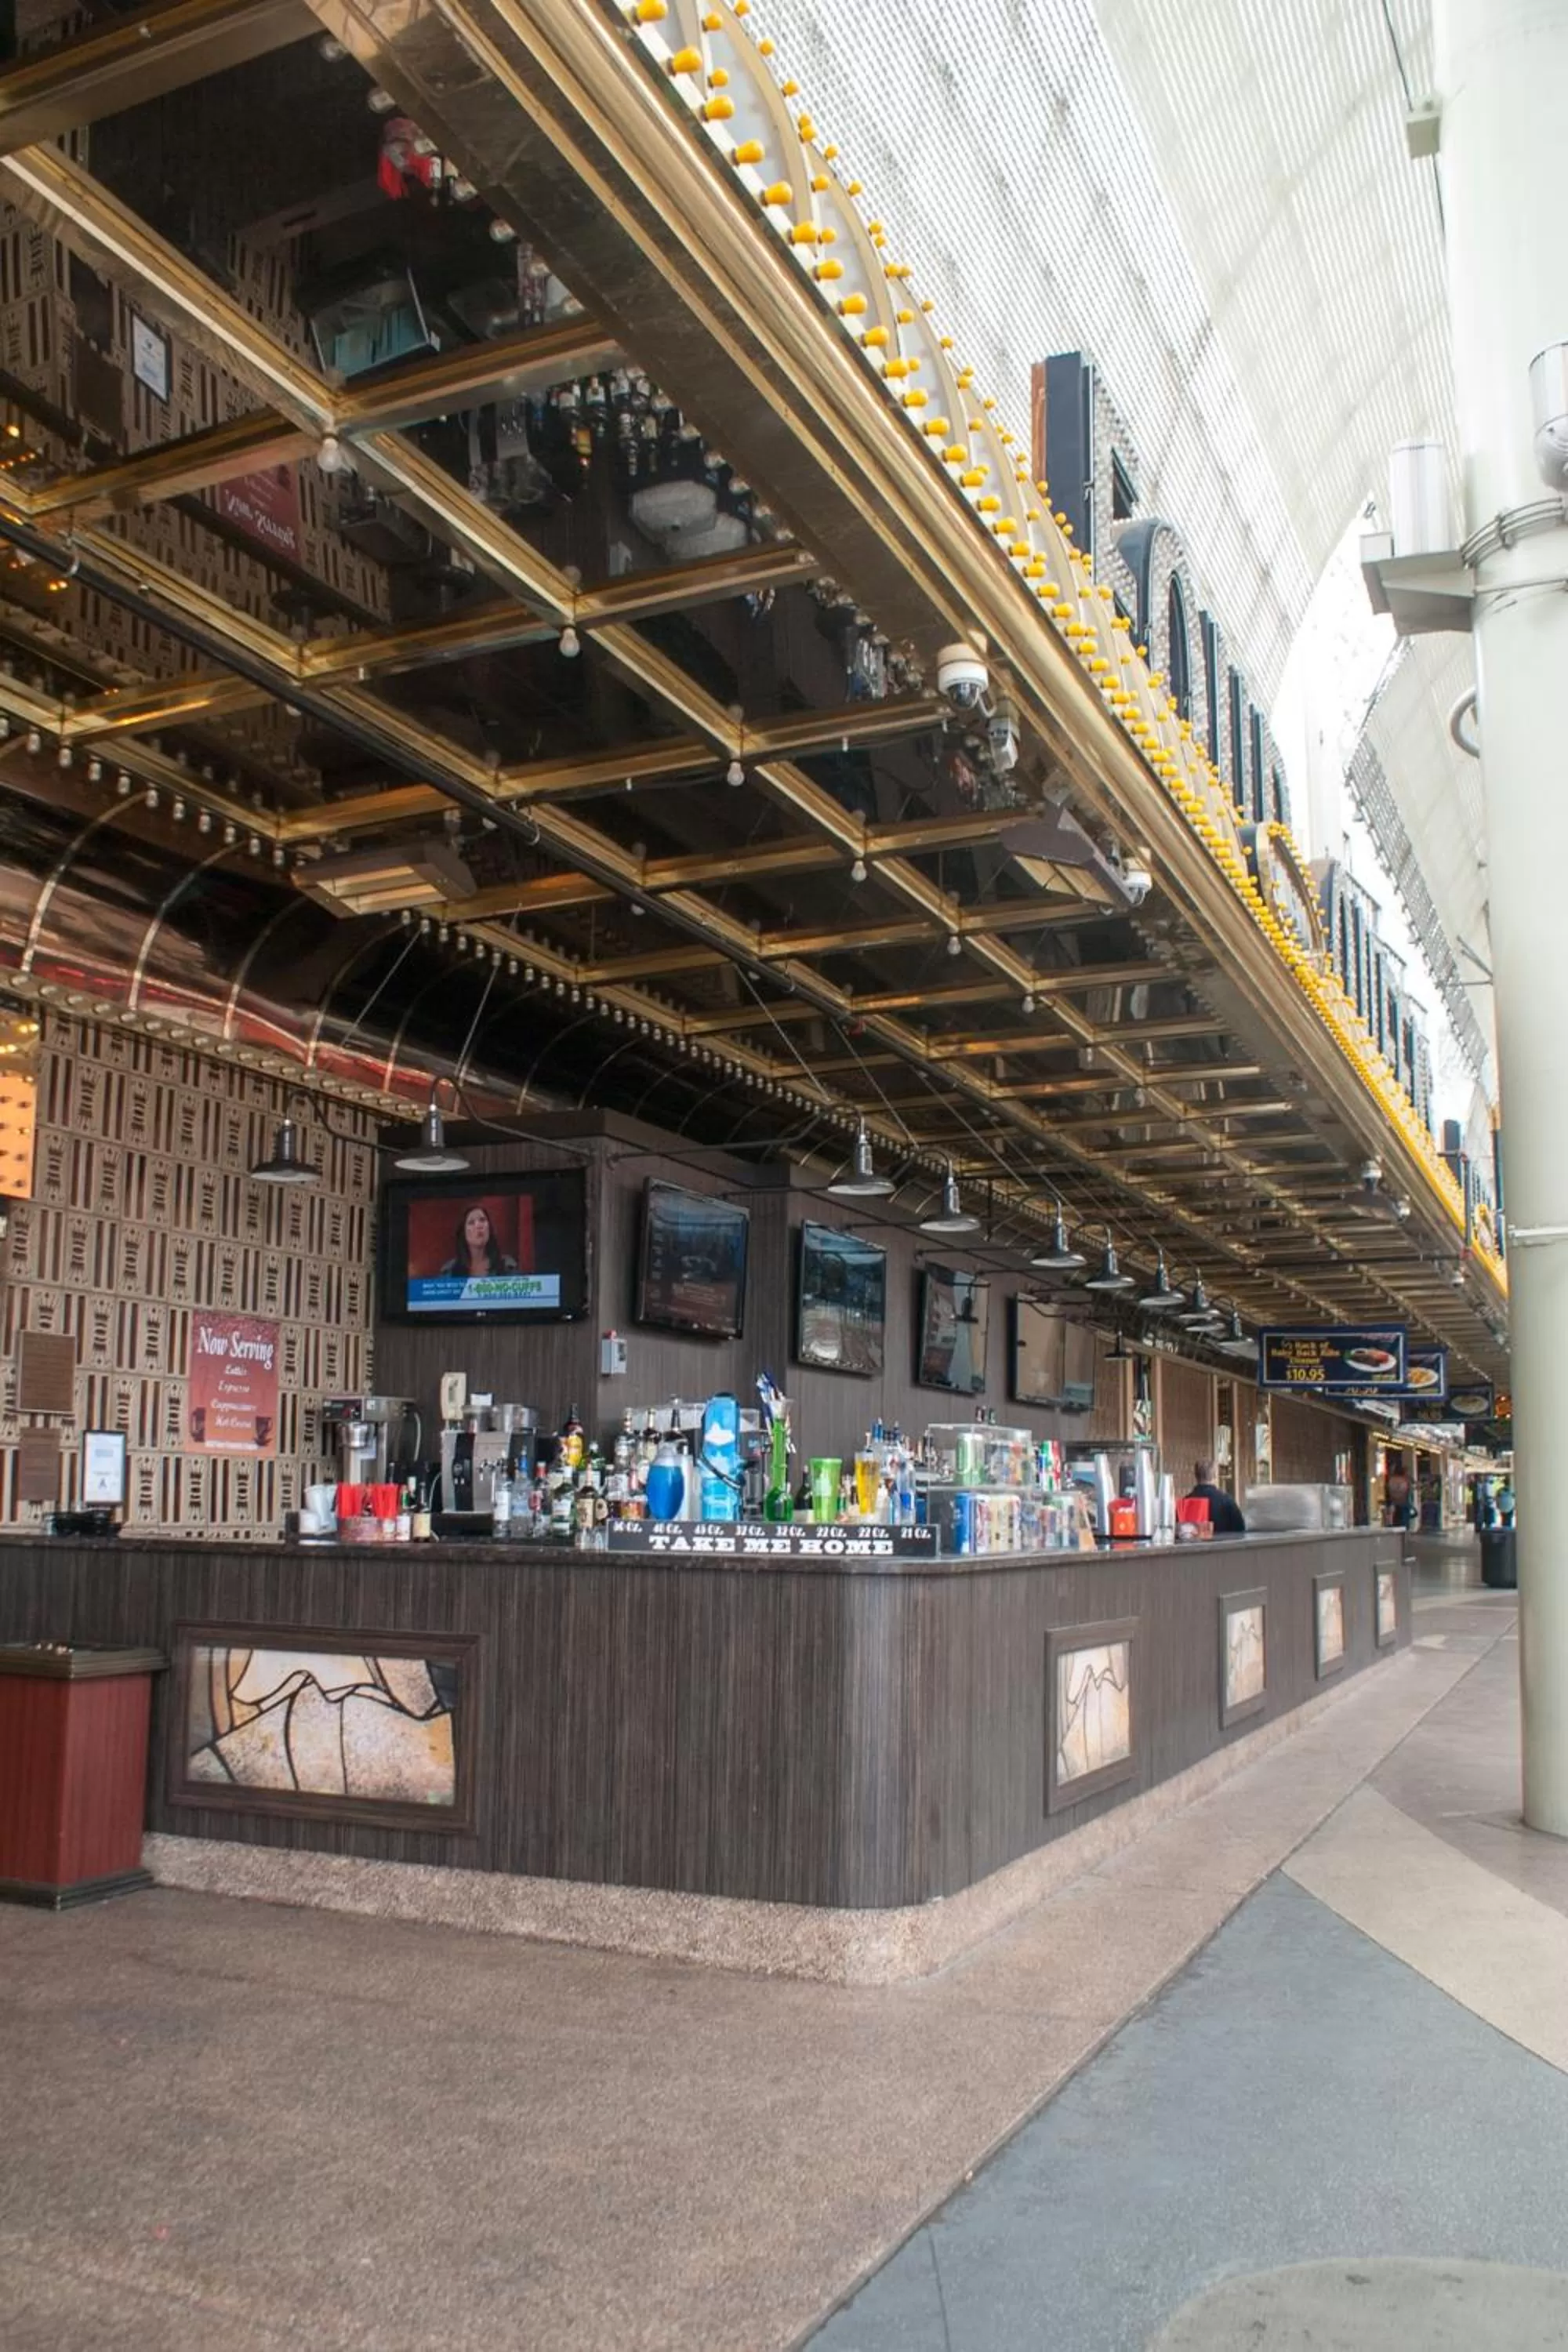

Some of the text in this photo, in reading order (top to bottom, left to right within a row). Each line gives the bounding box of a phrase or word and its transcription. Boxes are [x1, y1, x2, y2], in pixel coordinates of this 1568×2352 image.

[197, 1326, 274, 1370] Now Serving
[1286, 1368, 1326, 1381] $10.95
[648, 1534, 894, 1555] TAKE ME HOME
